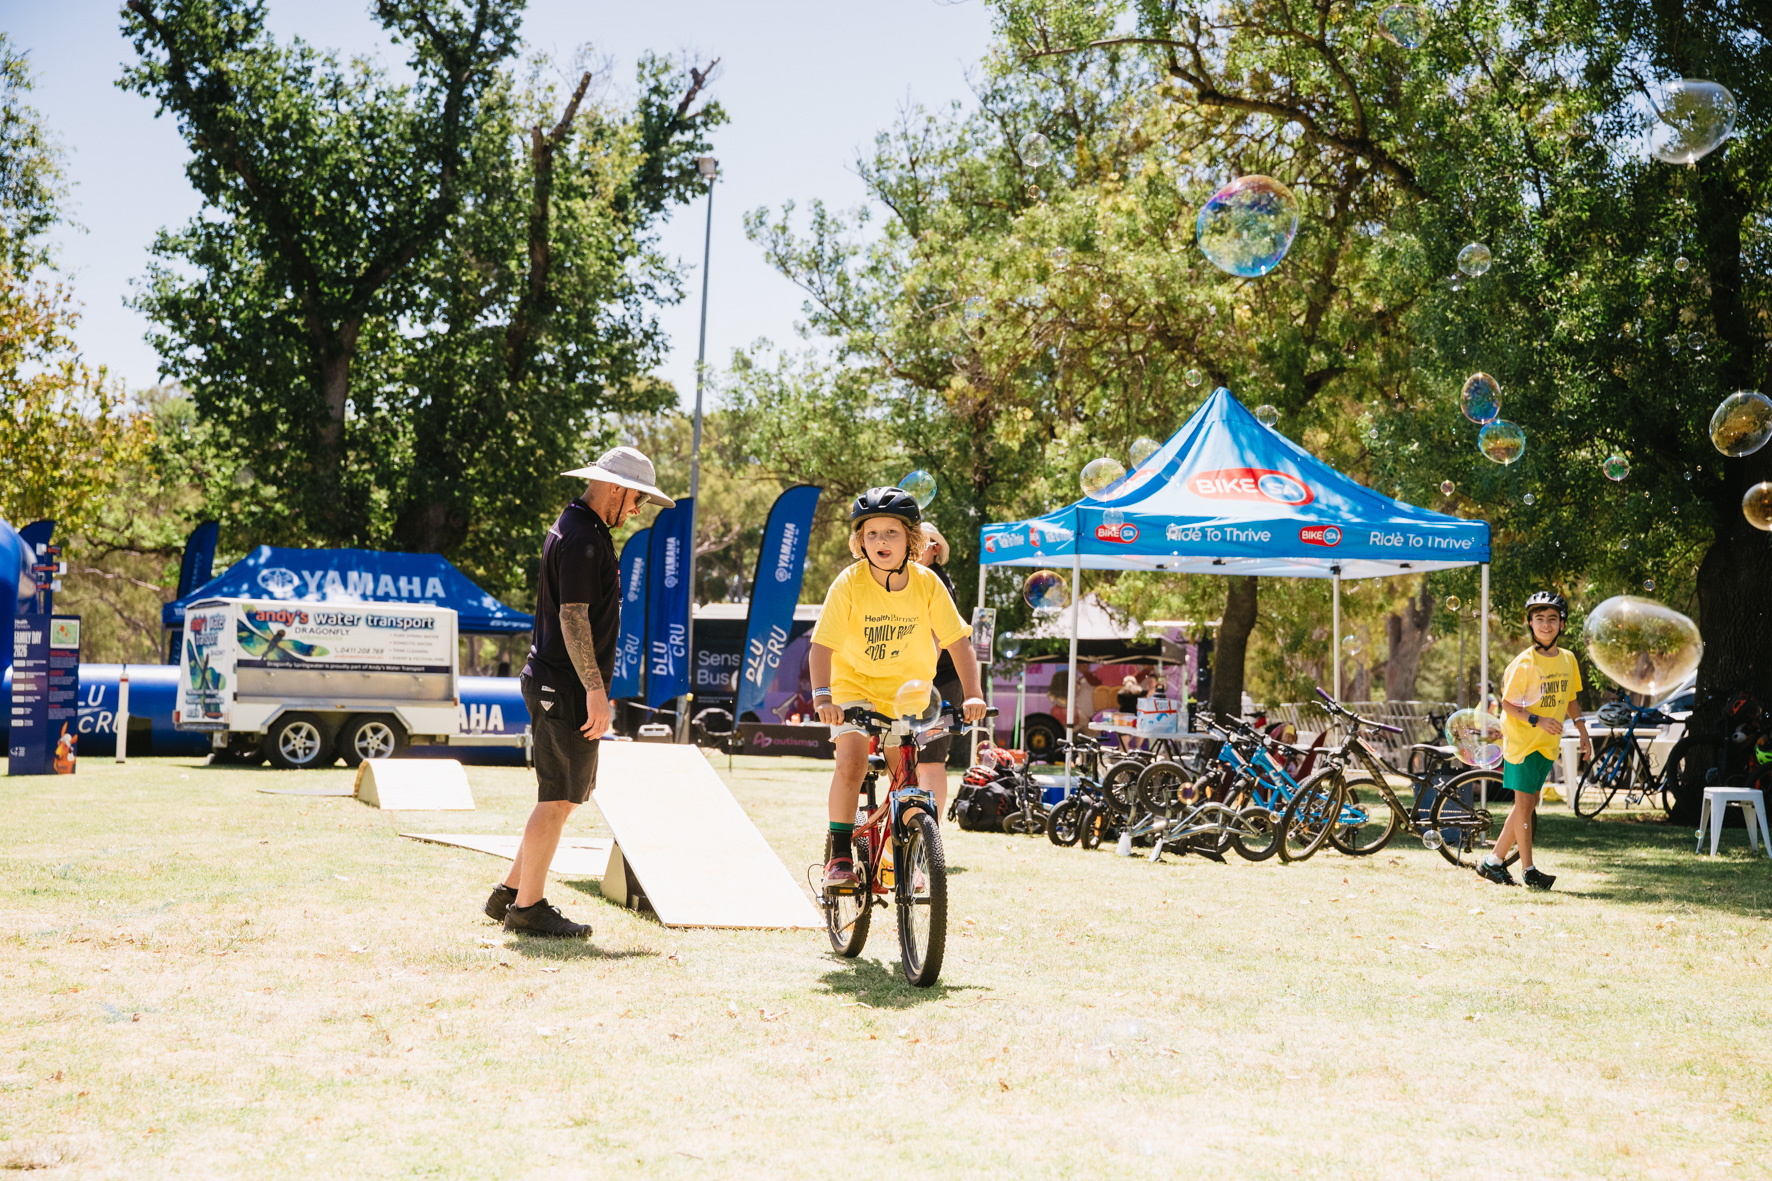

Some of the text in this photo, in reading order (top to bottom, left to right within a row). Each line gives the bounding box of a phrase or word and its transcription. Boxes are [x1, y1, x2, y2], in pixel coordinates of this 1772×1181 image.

[1195, 478, 1298, 498] BIKE SA
[1097, 528, 1135, 538] BIKE SA
[1167, 526, 1272, 542] Ride To Thrive
[1301, 530, 1323, 541] BIKE
[1369, 531, 1472, 550] Ride To Thrive
[777, 522, 796, 568] YAMAHA
[664, 536, 677, 577] YAMAHA
[301, 570, 447, 599] YAMAHA
[629, 557, 643, 592] YAMAHA
[255, 609, 435, 631] andy's water transport
[14, 631, 31, 645] FAMILY
[294, 626, 351, 636] DRAGONFLY
[669, 623, 686, 658] CRU
[864, 624, 896, 644] FAMILY
[625, 633, 641, 665] CRU
[767, 625, 788, 669] CRU
[697, 669, 730, 685] Bus
